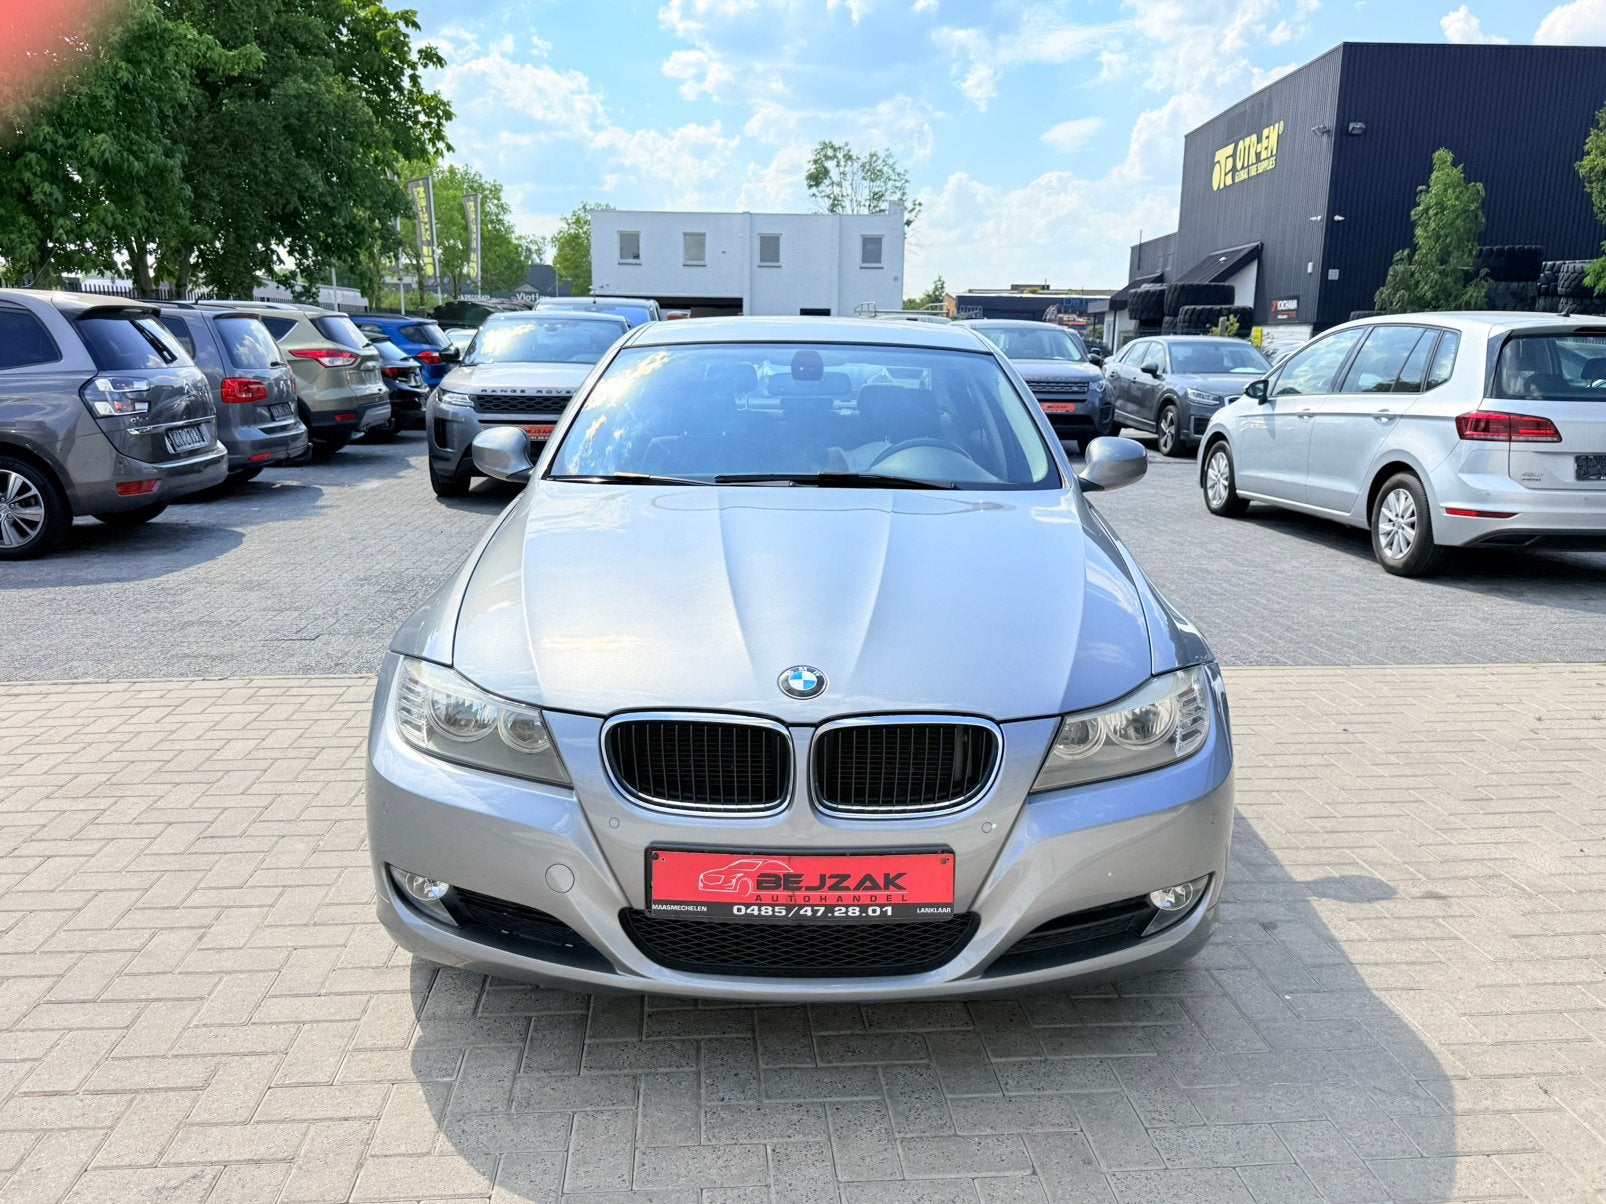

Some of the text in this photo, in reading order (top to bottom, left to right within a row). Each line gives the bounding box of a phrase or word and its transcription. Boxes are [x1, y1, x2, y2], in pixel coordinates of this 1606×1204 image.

[1236, 122, 1279, 171] OTR-EM
[756, 872, 908, 891] BEJZAK
[755, 894, 908, 903] AUTOHANDEL
[652, 904, 707, 912] MAASMECHELEN
[732, 904, 893, 917] 0485/47.28.01
